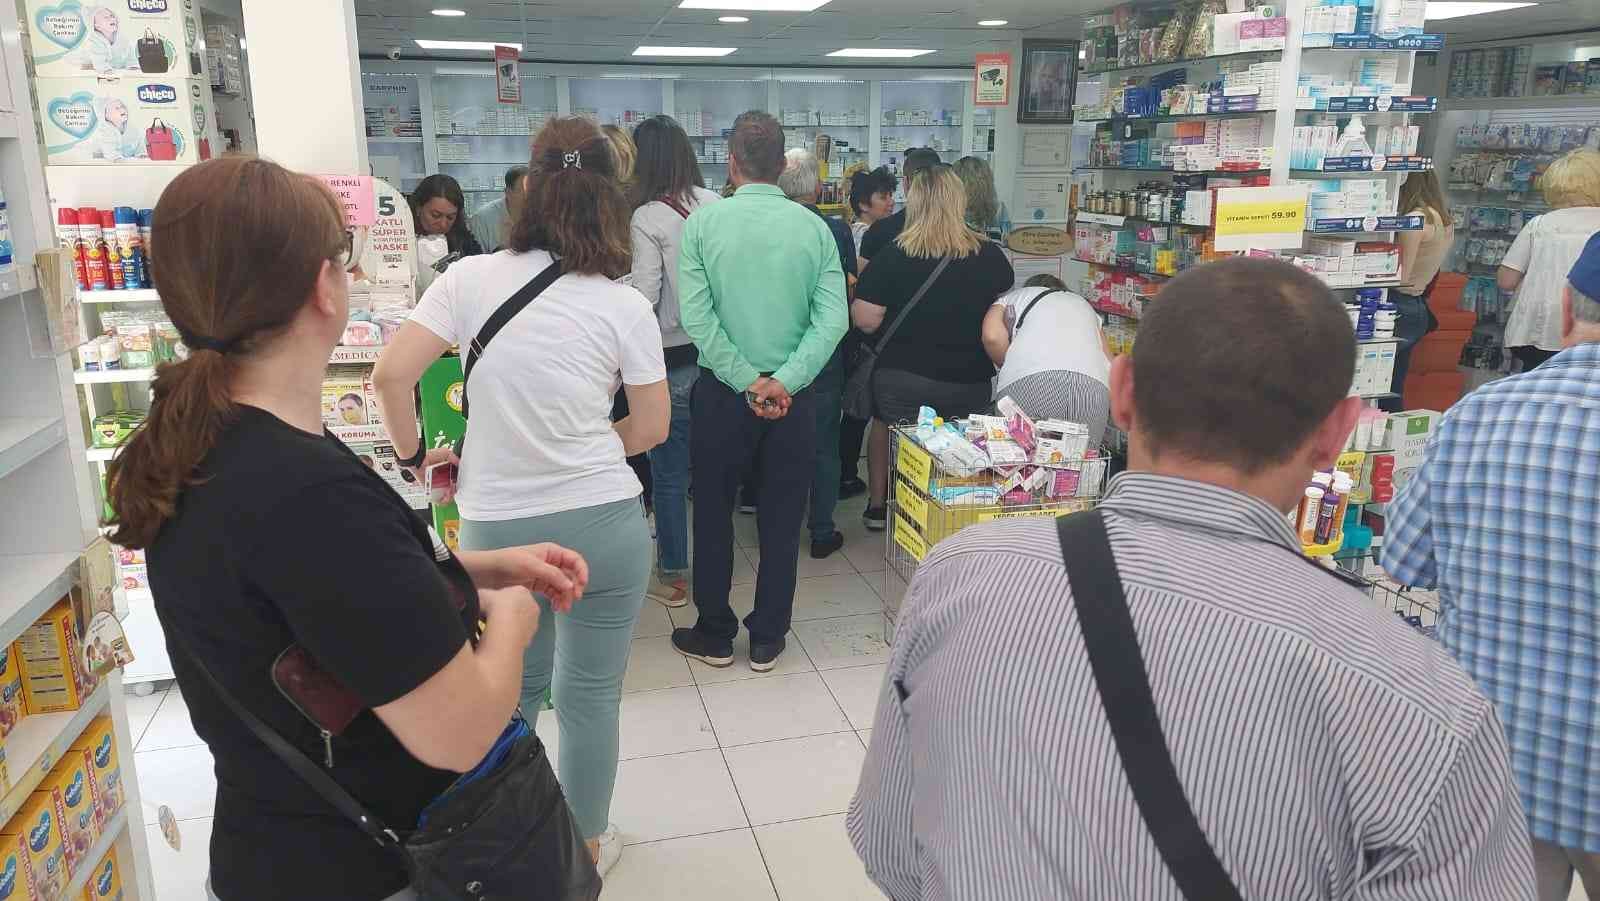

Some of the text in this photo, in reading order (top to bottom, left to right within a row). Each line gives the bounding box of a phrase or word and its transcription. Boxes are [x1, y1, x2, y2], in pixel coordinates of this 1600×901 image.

[139, 86, 174, 101] chicco
[379, 196, 395, 216] 5
[1271, 211, 1297, 219] 59.90
